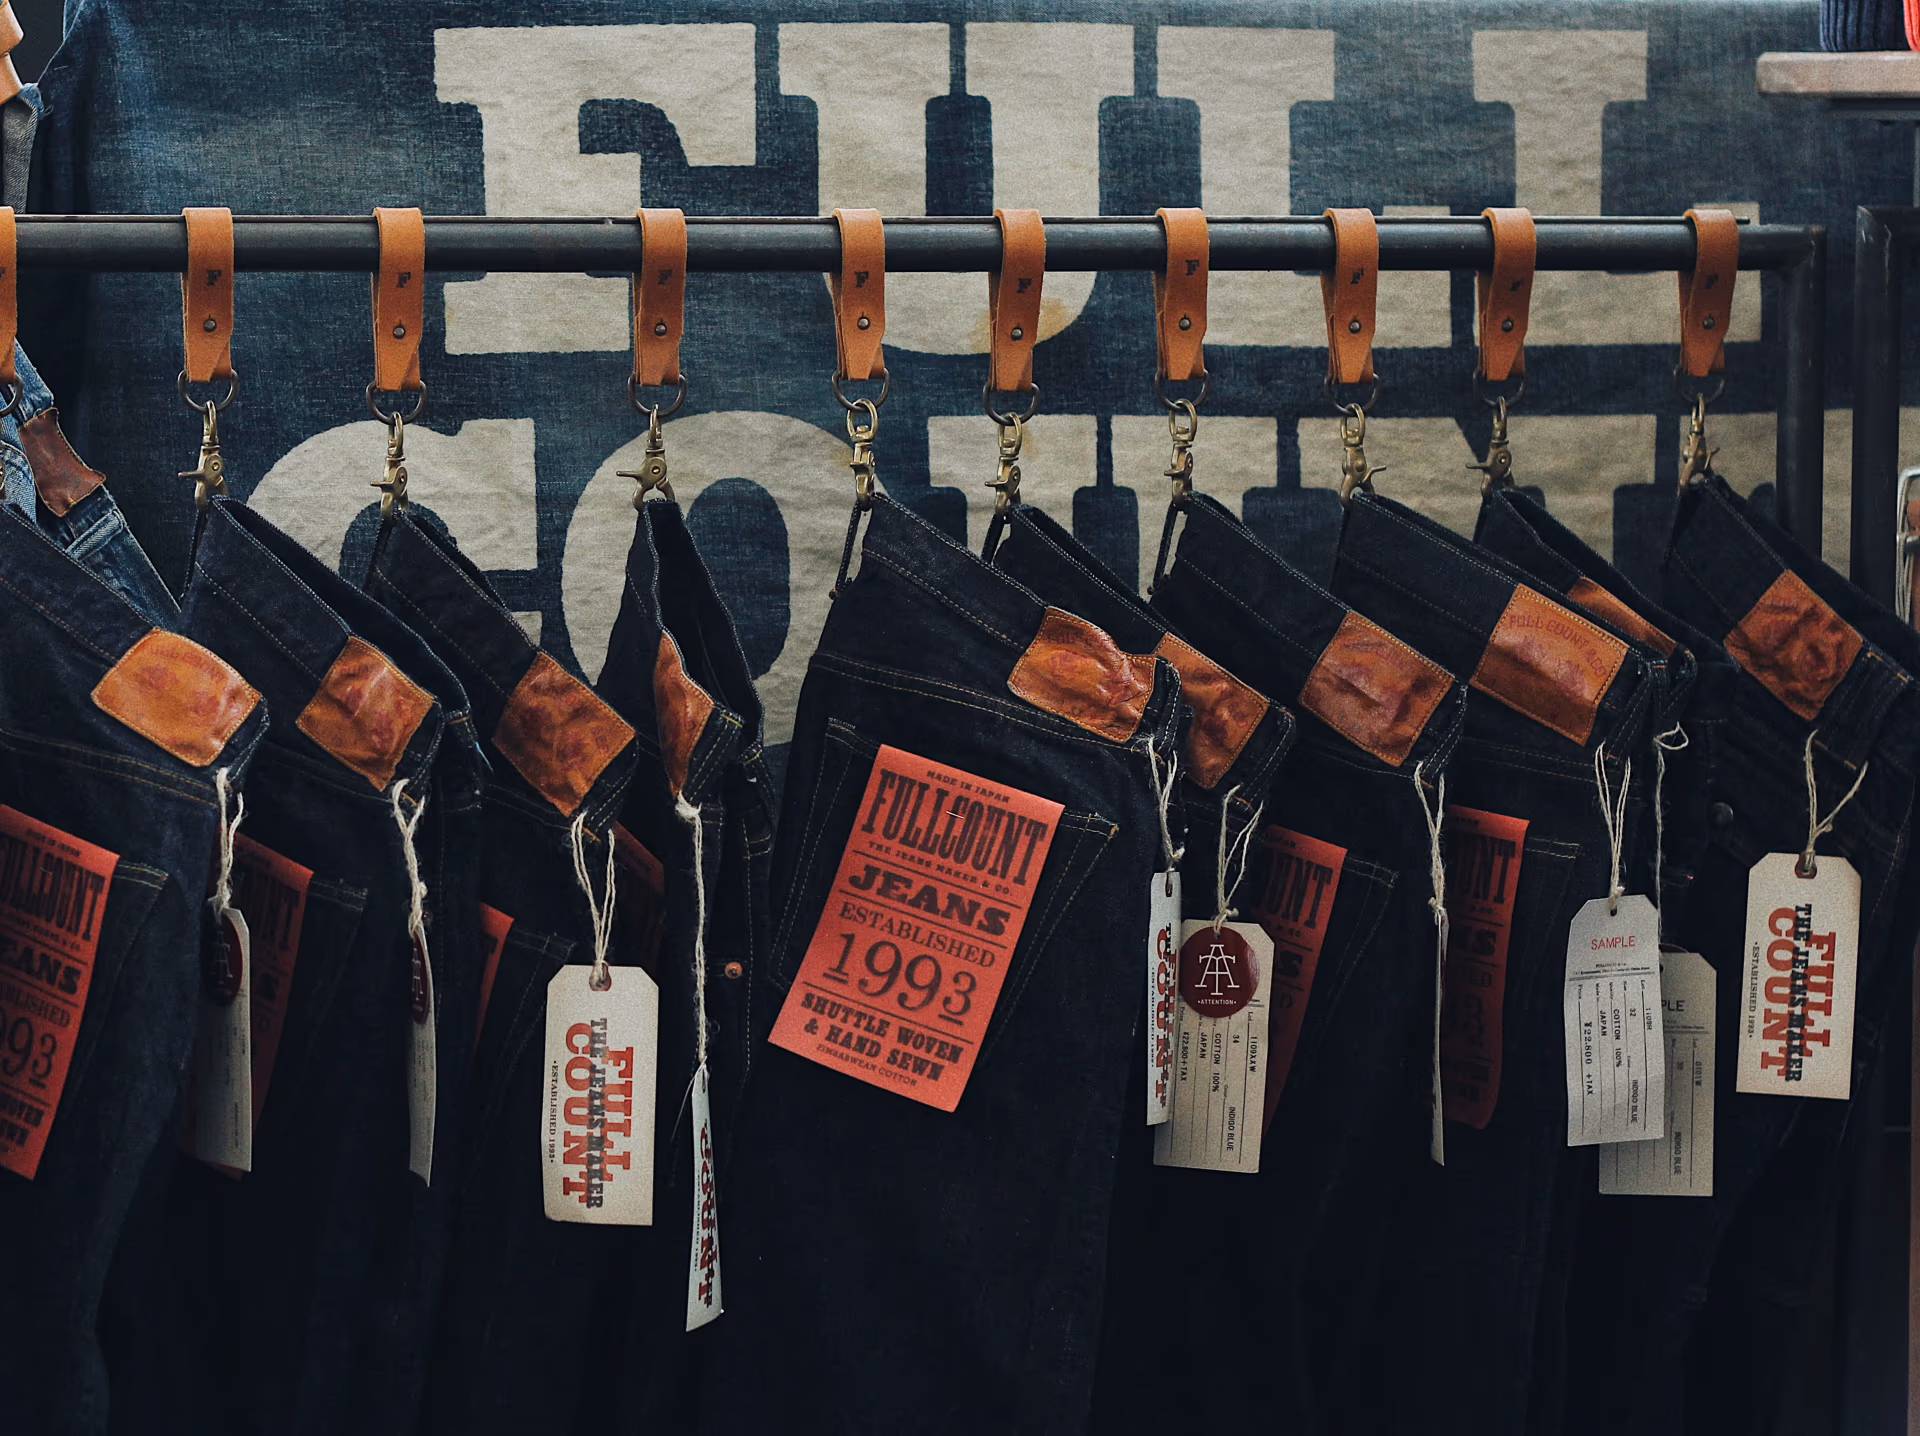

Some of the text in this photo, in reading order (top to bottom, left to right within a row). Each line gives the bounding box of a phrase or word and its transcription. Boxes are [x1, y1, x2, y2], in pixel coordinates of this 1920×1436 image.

[432, 20, 1764, 357] FULL
[926, 770, 1011, 804] MADE IN JAPAN
[861, 768, 1048, 886] FULLCOUNT
[869, 840, 892, 855] THE
[895, 849, 932, 868] JEANS
[936, 862, 978, 884] MAKER
[0, 832, 106, 941] ULLCOUNT
[848, 864, 1011, 937] JEANS
[0, 934, 82, 995] EANS
[838, 902, 995, 968] ESTABLISHED
[1591, 935, 1636, 951] SAMPLE
[823, 932, 977, 1025] 1993
[1201, 998, 1234, 1006] ATTENTION
[1630, 1008, 1636, 1017] 32
[1747, 946, 1760, 1034] ESTABLISHED 1993
[1761, 907, 1797, 1076] COUNT
[1785, 904, 1812, 1082] THE JEANS MAKER
[1799, 931, 1836, 1057] FULL
[0, 1008, 57, 1089] 93
[801, 992, 964, 1064] SHUTTLE WOVEN
[803, 1017, 945, 1082] & HAND SEWN
[1156, 929, 1167, 1104] COUNT
[1199, 1032, 1207, 1058] JAPAN
[1213, 1033, 1222, 1065] COTTON
[1232, 1035, 1239, 1044] 34
[816, 1043, 918, 1086] ZIMBABWEAN COTTON
[1212, 1072, 1220, 1092] 100%
[1249, 1036, 1258, 1072] 1109XXW
[549, 1065, 558, 1135] ESTABLISHED
[563, 1022, 595, 1203] COUNT
[586, 1018, 607, 1209] THE JEANS MAKER
[600, 1046, 633, 1182] FULL
[1226, 1133, 1234, 1151] BLUE
[698, 1127, 710, 1304] COUNT
